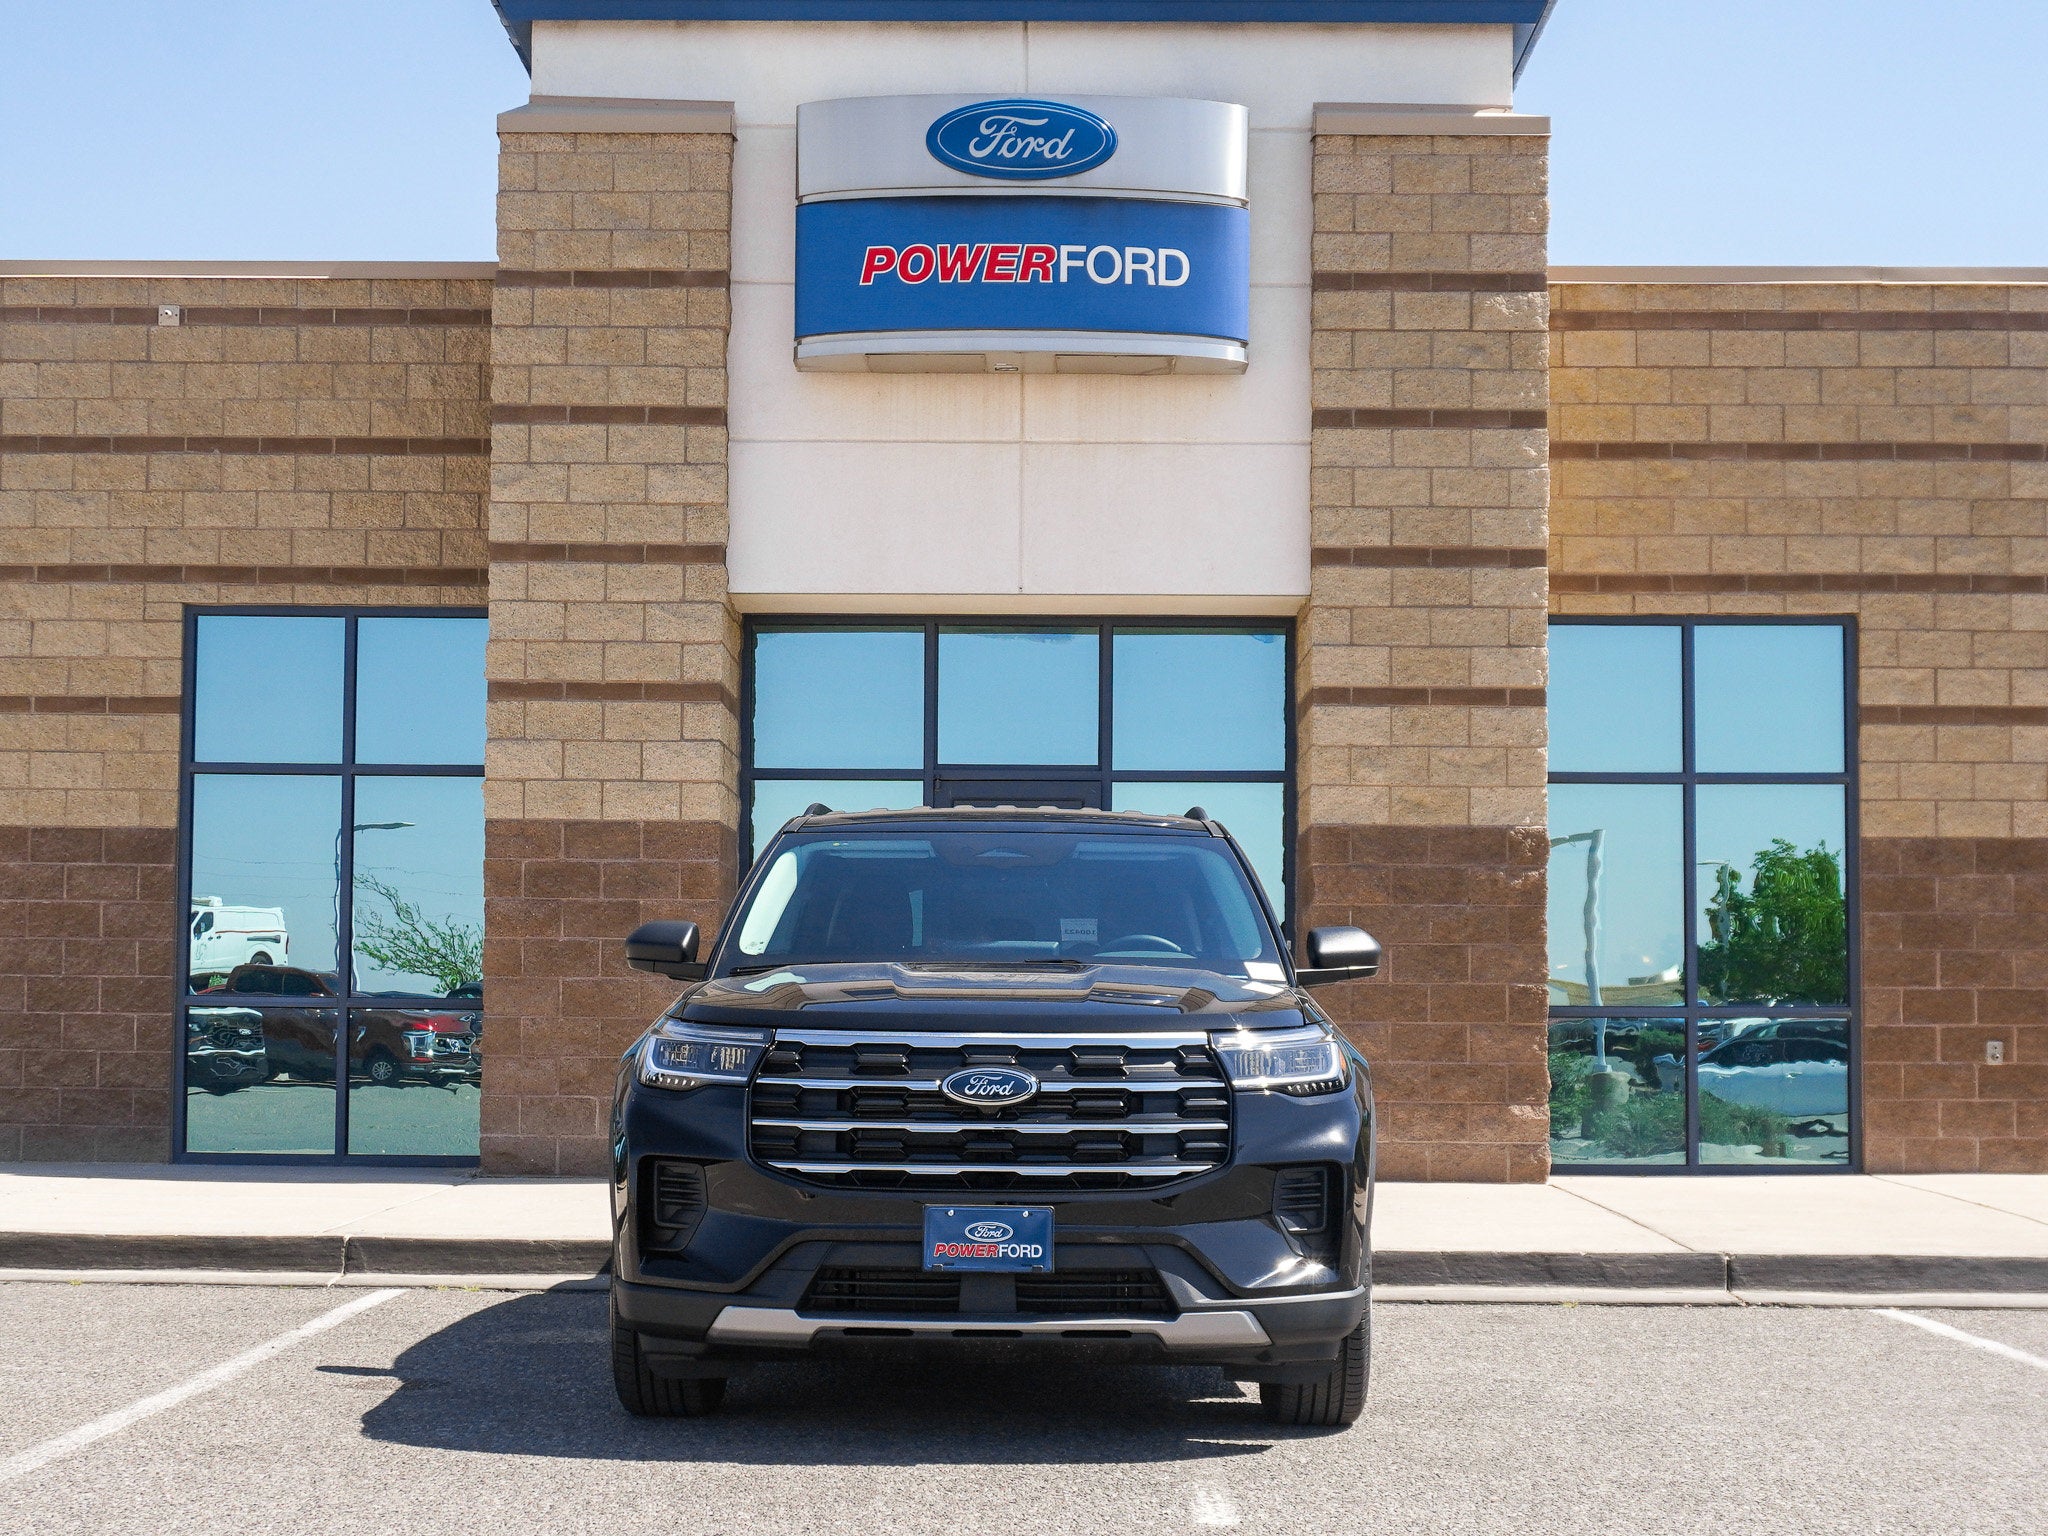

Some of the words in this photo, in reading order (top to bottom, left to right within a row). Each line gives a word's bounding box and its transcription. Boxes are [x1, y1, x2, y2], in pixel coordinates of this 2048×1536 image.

[969, 115, 1075, 159] Ford
[964, 1075, 1014, 1096] Ford
[974, 1226, 1003, 1238] Ford
